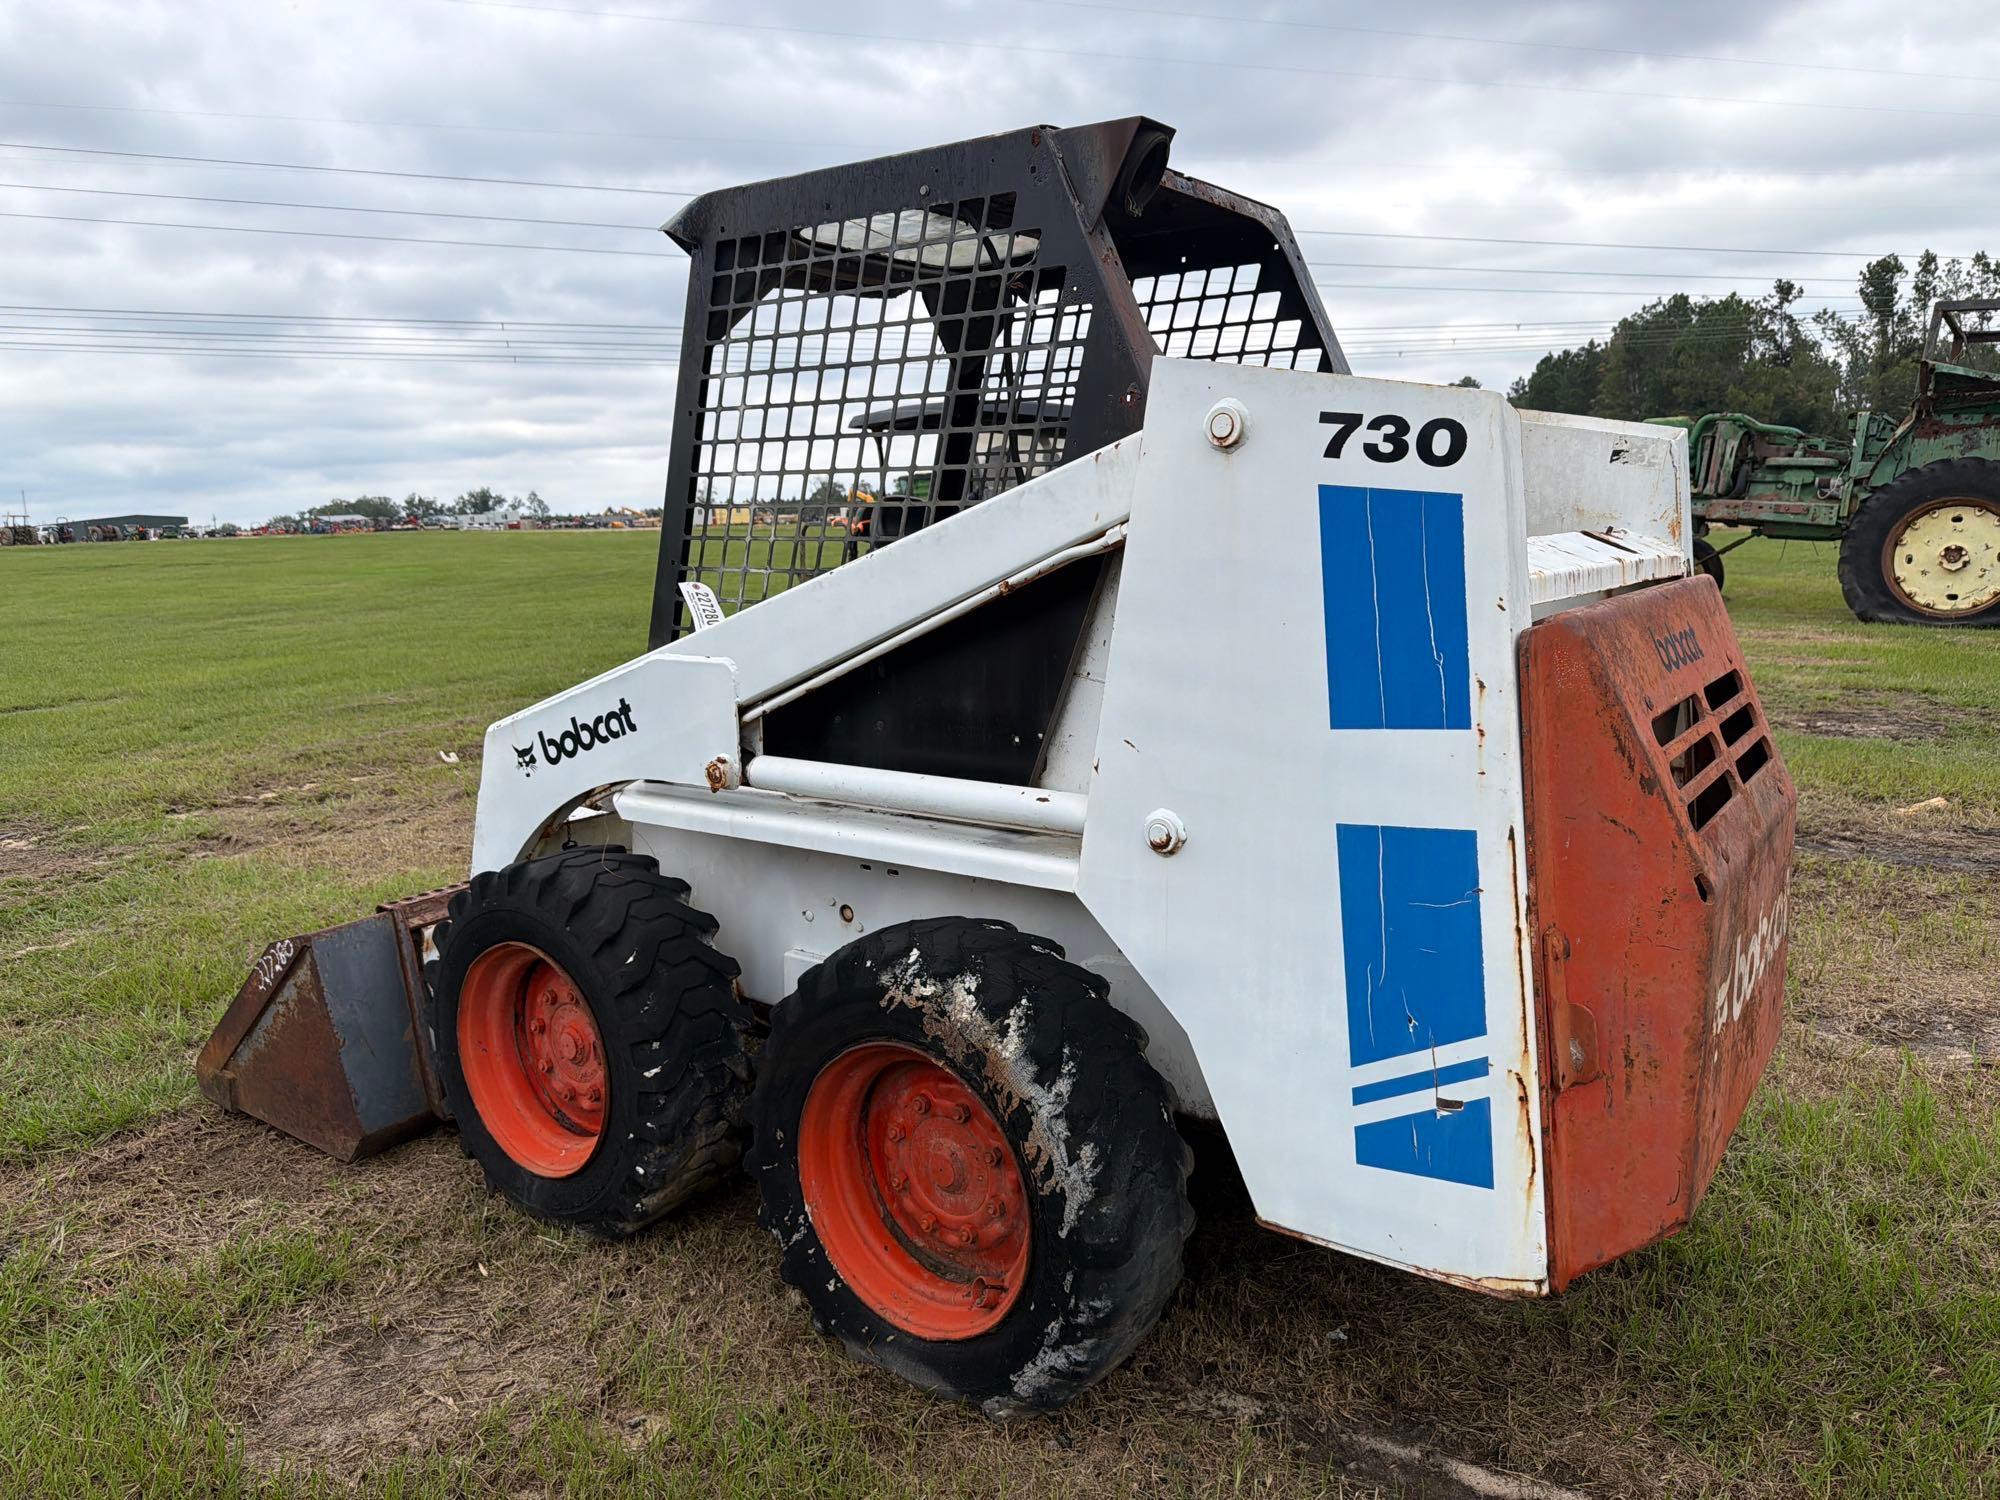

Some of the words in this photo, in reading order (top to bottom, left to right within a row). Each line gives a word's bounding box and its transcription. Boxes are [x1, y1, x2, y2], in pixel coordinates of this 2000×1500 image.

[1319, 411, 1468, 467] 730
[1647, 620, 1705, 673] bobcat
[537, 697, 638, 766] bobcat
